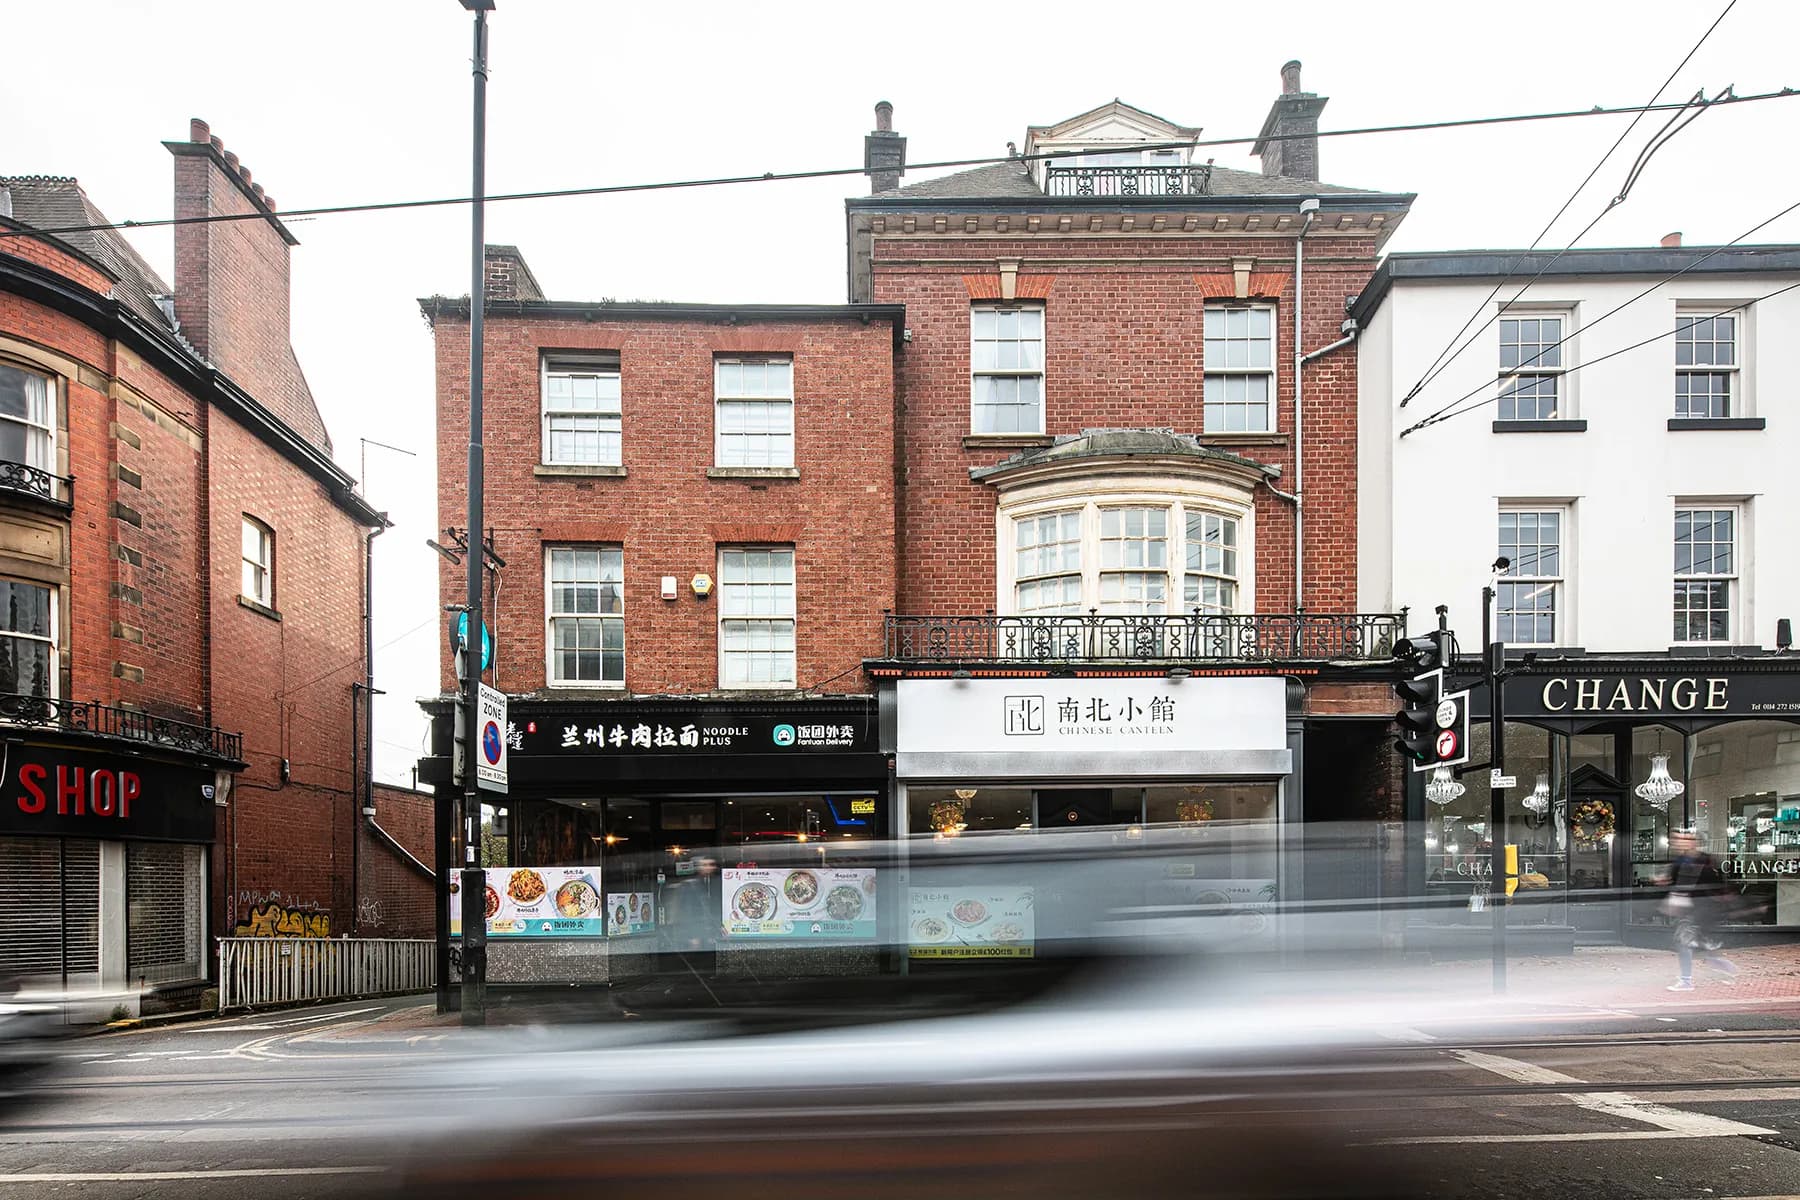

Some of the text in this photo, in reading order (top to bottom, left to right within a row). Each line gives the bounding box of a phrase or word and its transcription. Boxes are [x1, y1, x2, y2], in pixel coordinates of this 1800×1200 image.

[1542, 678, 1729, 711] CHANGE
[483, 702, 502, 721] ZONE
[1057, 695, 1176, 723] 南北小館
[561, 723, 699, 748] 兰州牛肉拉面
[703, 727, 749, 736] NOODLE
[797, 725, 854, 738] 饭团外卖
[1059, 726, 1174, 735] CHINESE CANTEEN
[703, 737, 731, 746] PLUS
[826, 739, 854, 747] Delivery
[17, 763, 141, 818] SHOP
[1720, 860, 1798, 874] CHANGE
